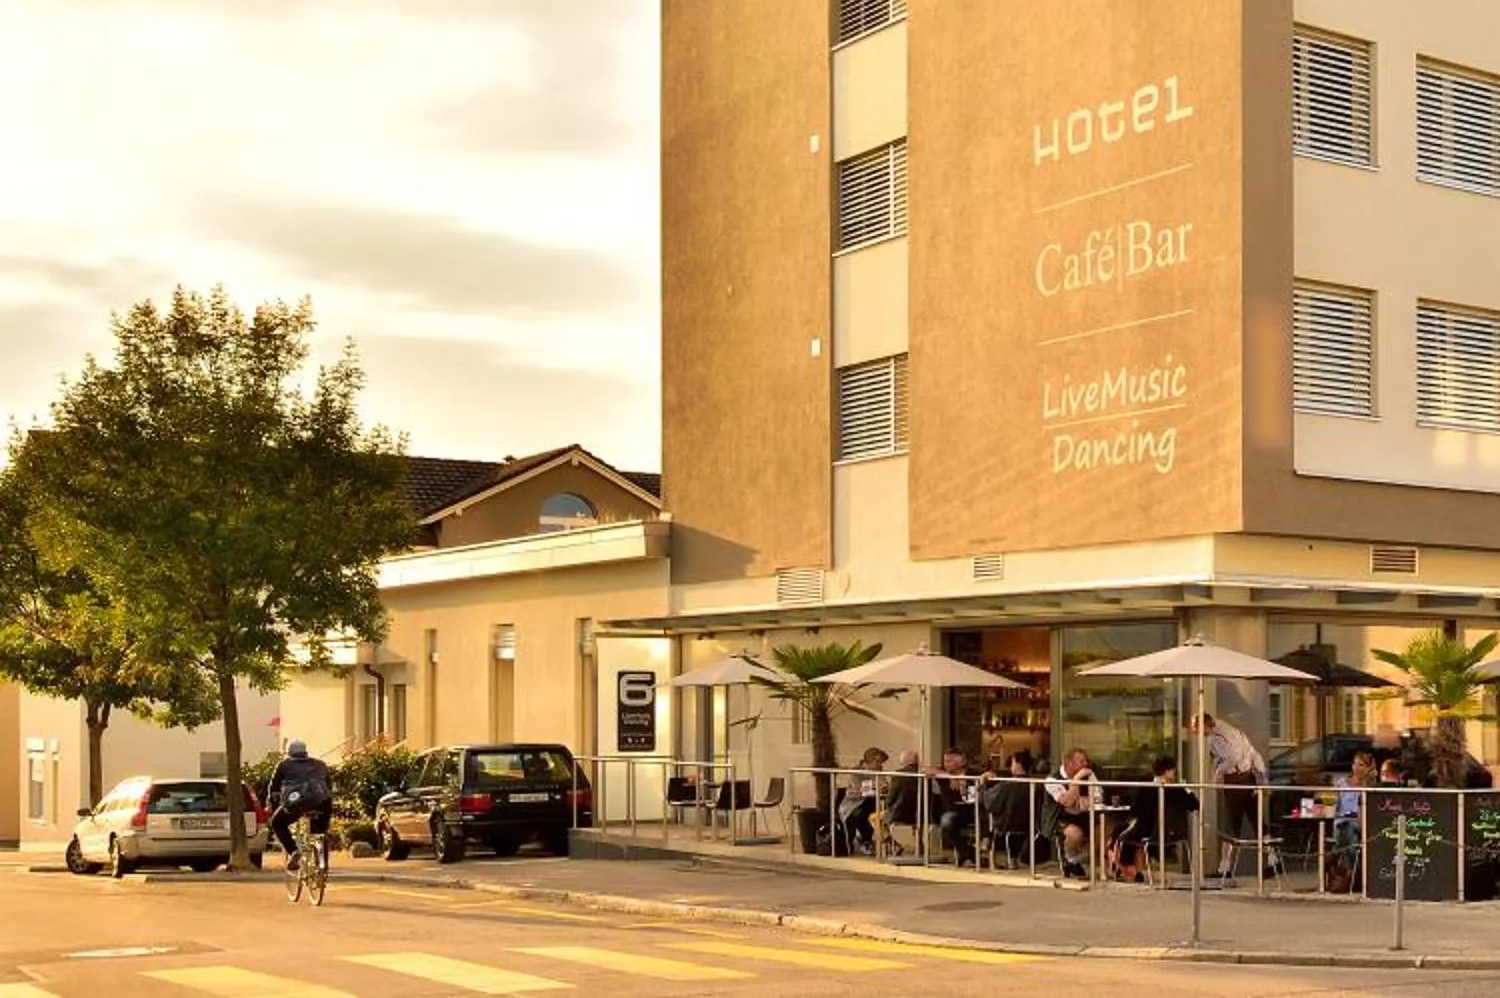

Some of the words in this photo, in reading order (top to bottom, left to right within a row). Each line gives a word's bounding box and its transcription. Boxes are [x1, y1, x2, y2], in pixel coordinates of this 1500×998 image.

[1042, 354, 1188, 420] LiveMusic
[1052, 418, 1177, 475] Dancing
[619, 673, 653, 706] 6
